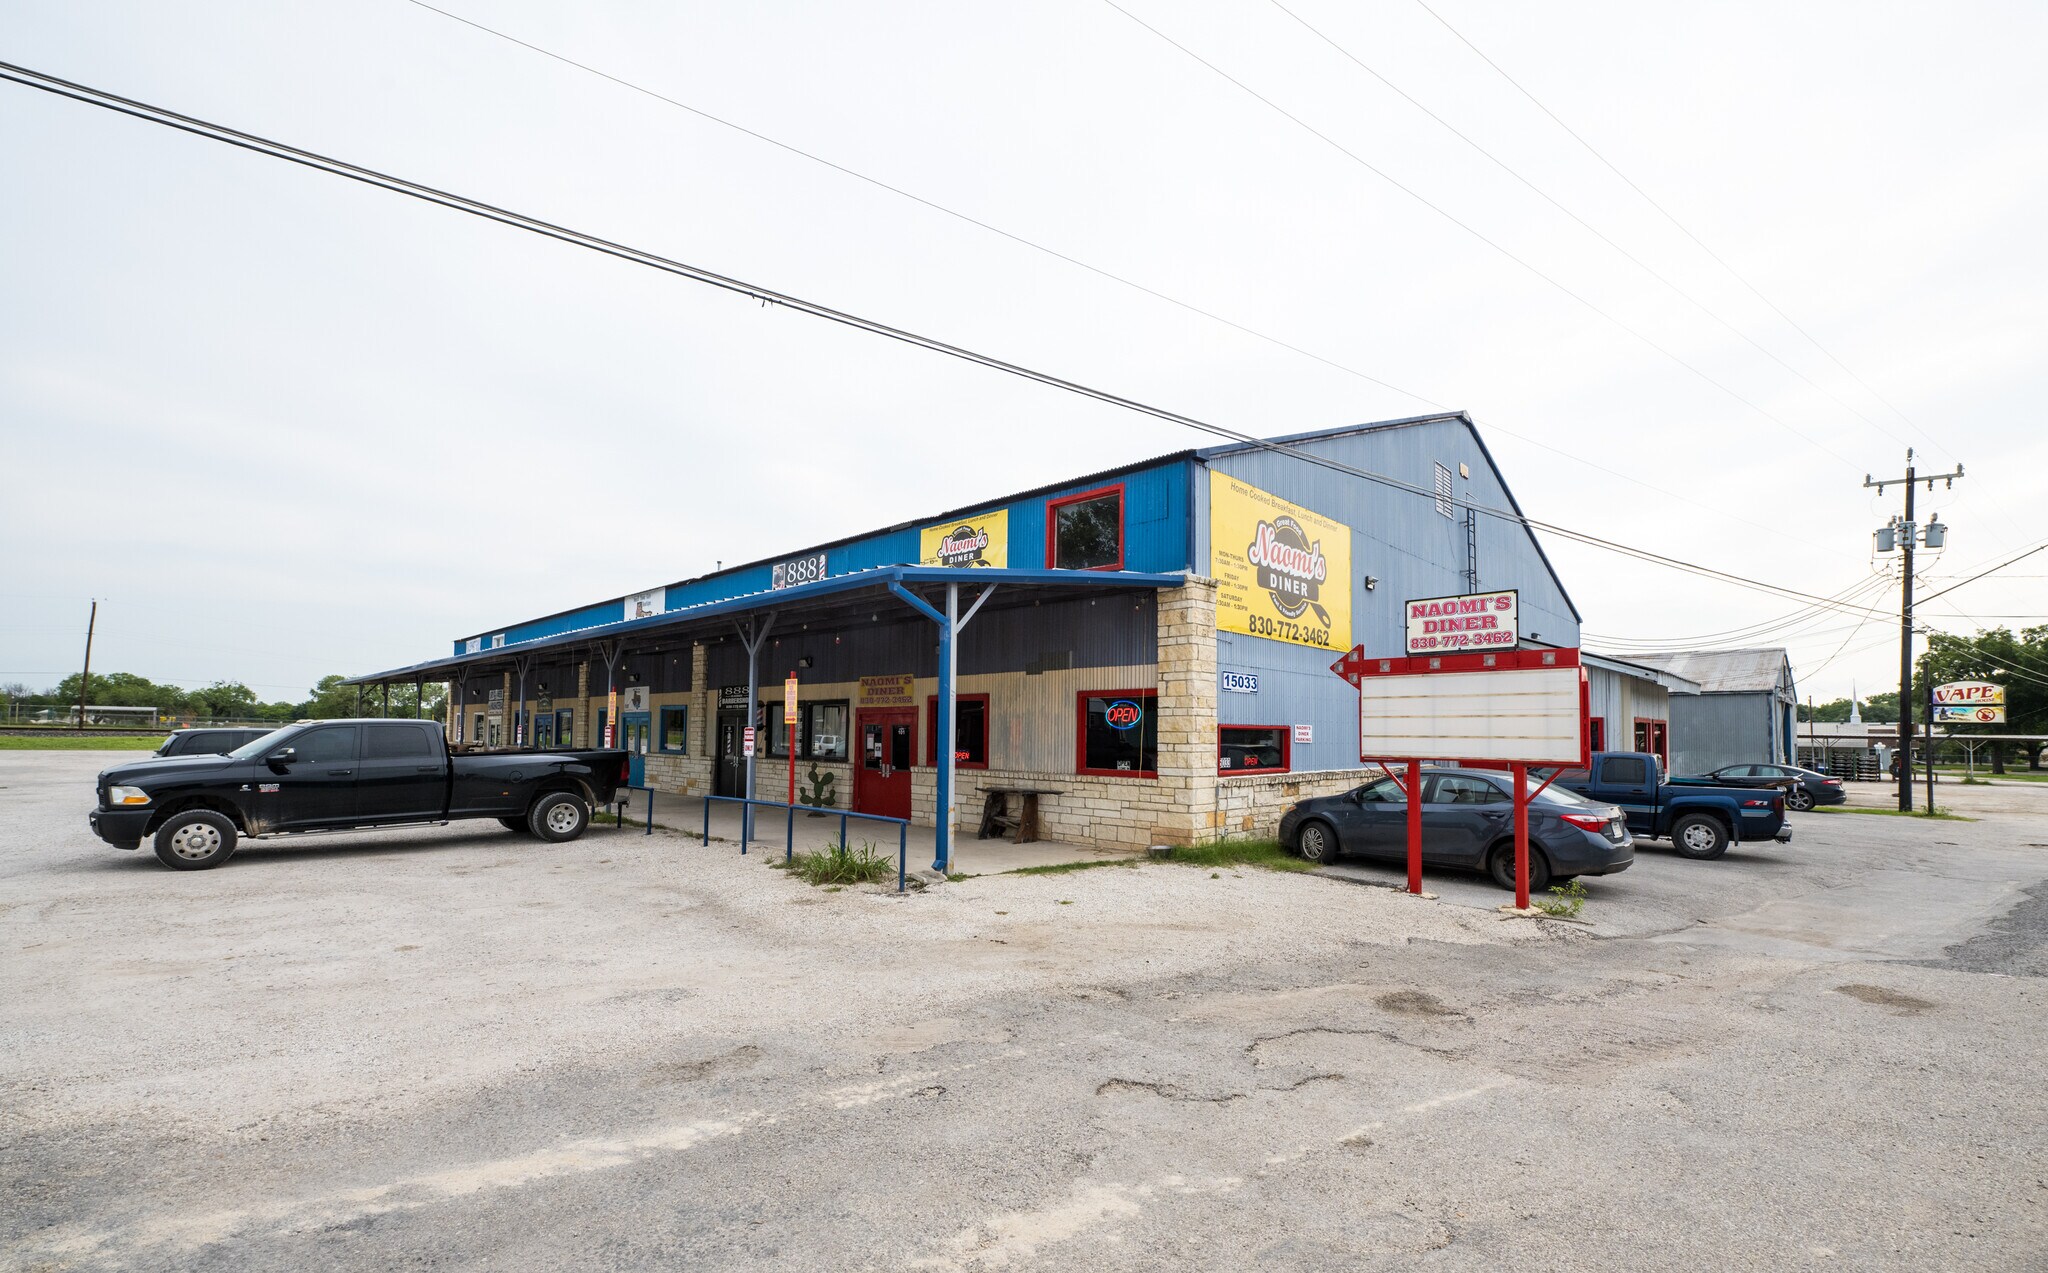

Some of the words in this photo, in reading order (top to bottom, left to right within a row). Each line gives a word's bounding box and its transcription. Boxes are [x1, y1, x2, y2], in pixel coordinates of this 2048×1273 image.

[1230, 482, 1248, 496] Home
[1249, 490, 1271, 505] Cooked
[1271, 499, 1297, 517] Breakfast,
[1297, 510, 1313, 522] Lunch
[1313, 518, 1322, 527] and
[1322, 520, 1338, 532] Dinner
[1276, 518, 1290, 528] Great
[1290, 520, 1303, 535] Food
[938, 527, 988, 557] Naomi's
[949, 552, 974, 564] DINER
[1249, 523, 1326, 581] Naomi's
[787, 557, 817, 583] 888
[1224, 572, 1240, 581] FRIDAY
[1269, 573, 1308, 597] DINER
[1220, 592, 1243, 602] SATURDAY
[1410, 595, 1512, 619] NAOMI'S
[1249, 614, 1330, 646] 830-772-3462
[1423, 615, 1498, 634] DINER
[1410, 631, 1513, 649] 830-772-3462
[725, 685, 749, 695] 888
[1224, 674, 1257, 690] 15033
[867, 686, 904, 696] DINER
[1936, 685, 1995, 702] VAPE
[1108, 707, 1138, 722] OPEN
[954, 751, 970, 760] OPEN
[1243, 756, 1259, 767] OPEN
